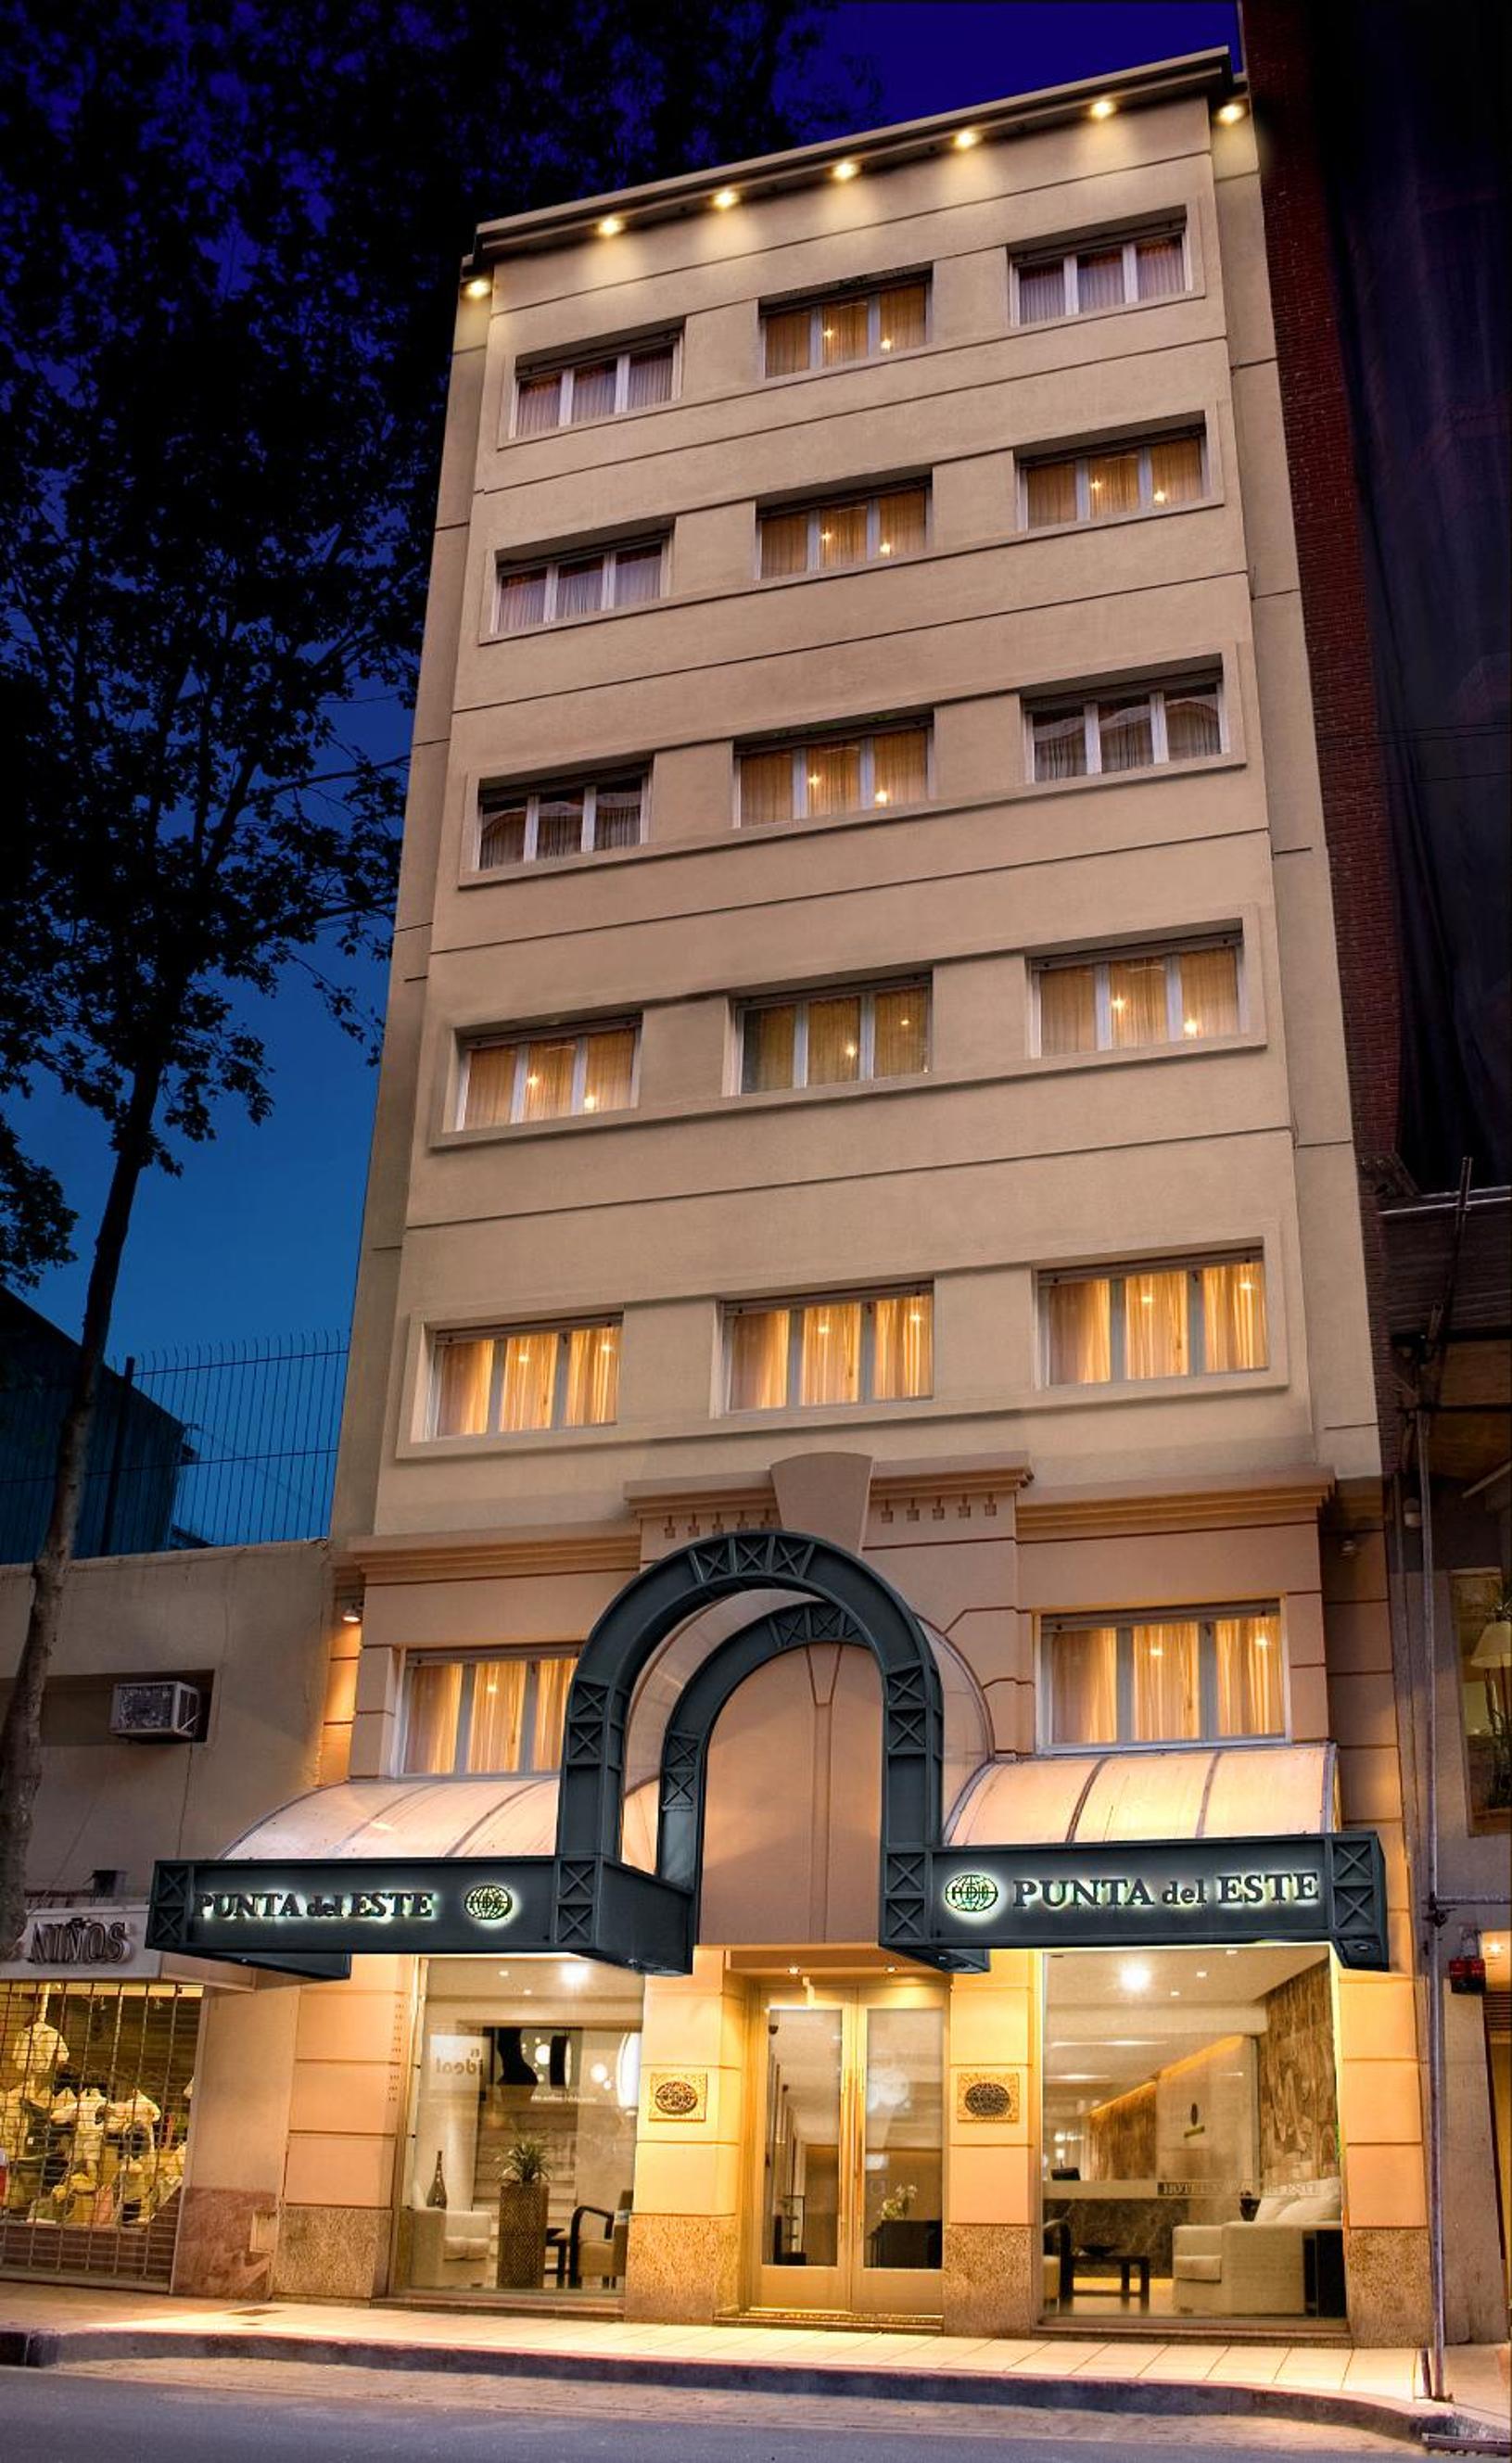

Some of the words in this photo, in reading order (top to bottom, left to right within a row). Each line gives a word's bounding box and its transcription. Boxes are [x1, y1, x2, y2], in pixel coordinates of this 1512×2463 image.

[1012, 1877, 1156, 1907] PUNTA
[1161, 1878, 1208, 1905] del
[1216, 1872, 1320, 1904] ESTE
[193, 1892, 304, 1918] PUNTA
[306, 1894, 344, 1918] del
[349, 1892, 434, 1917] ESTE
